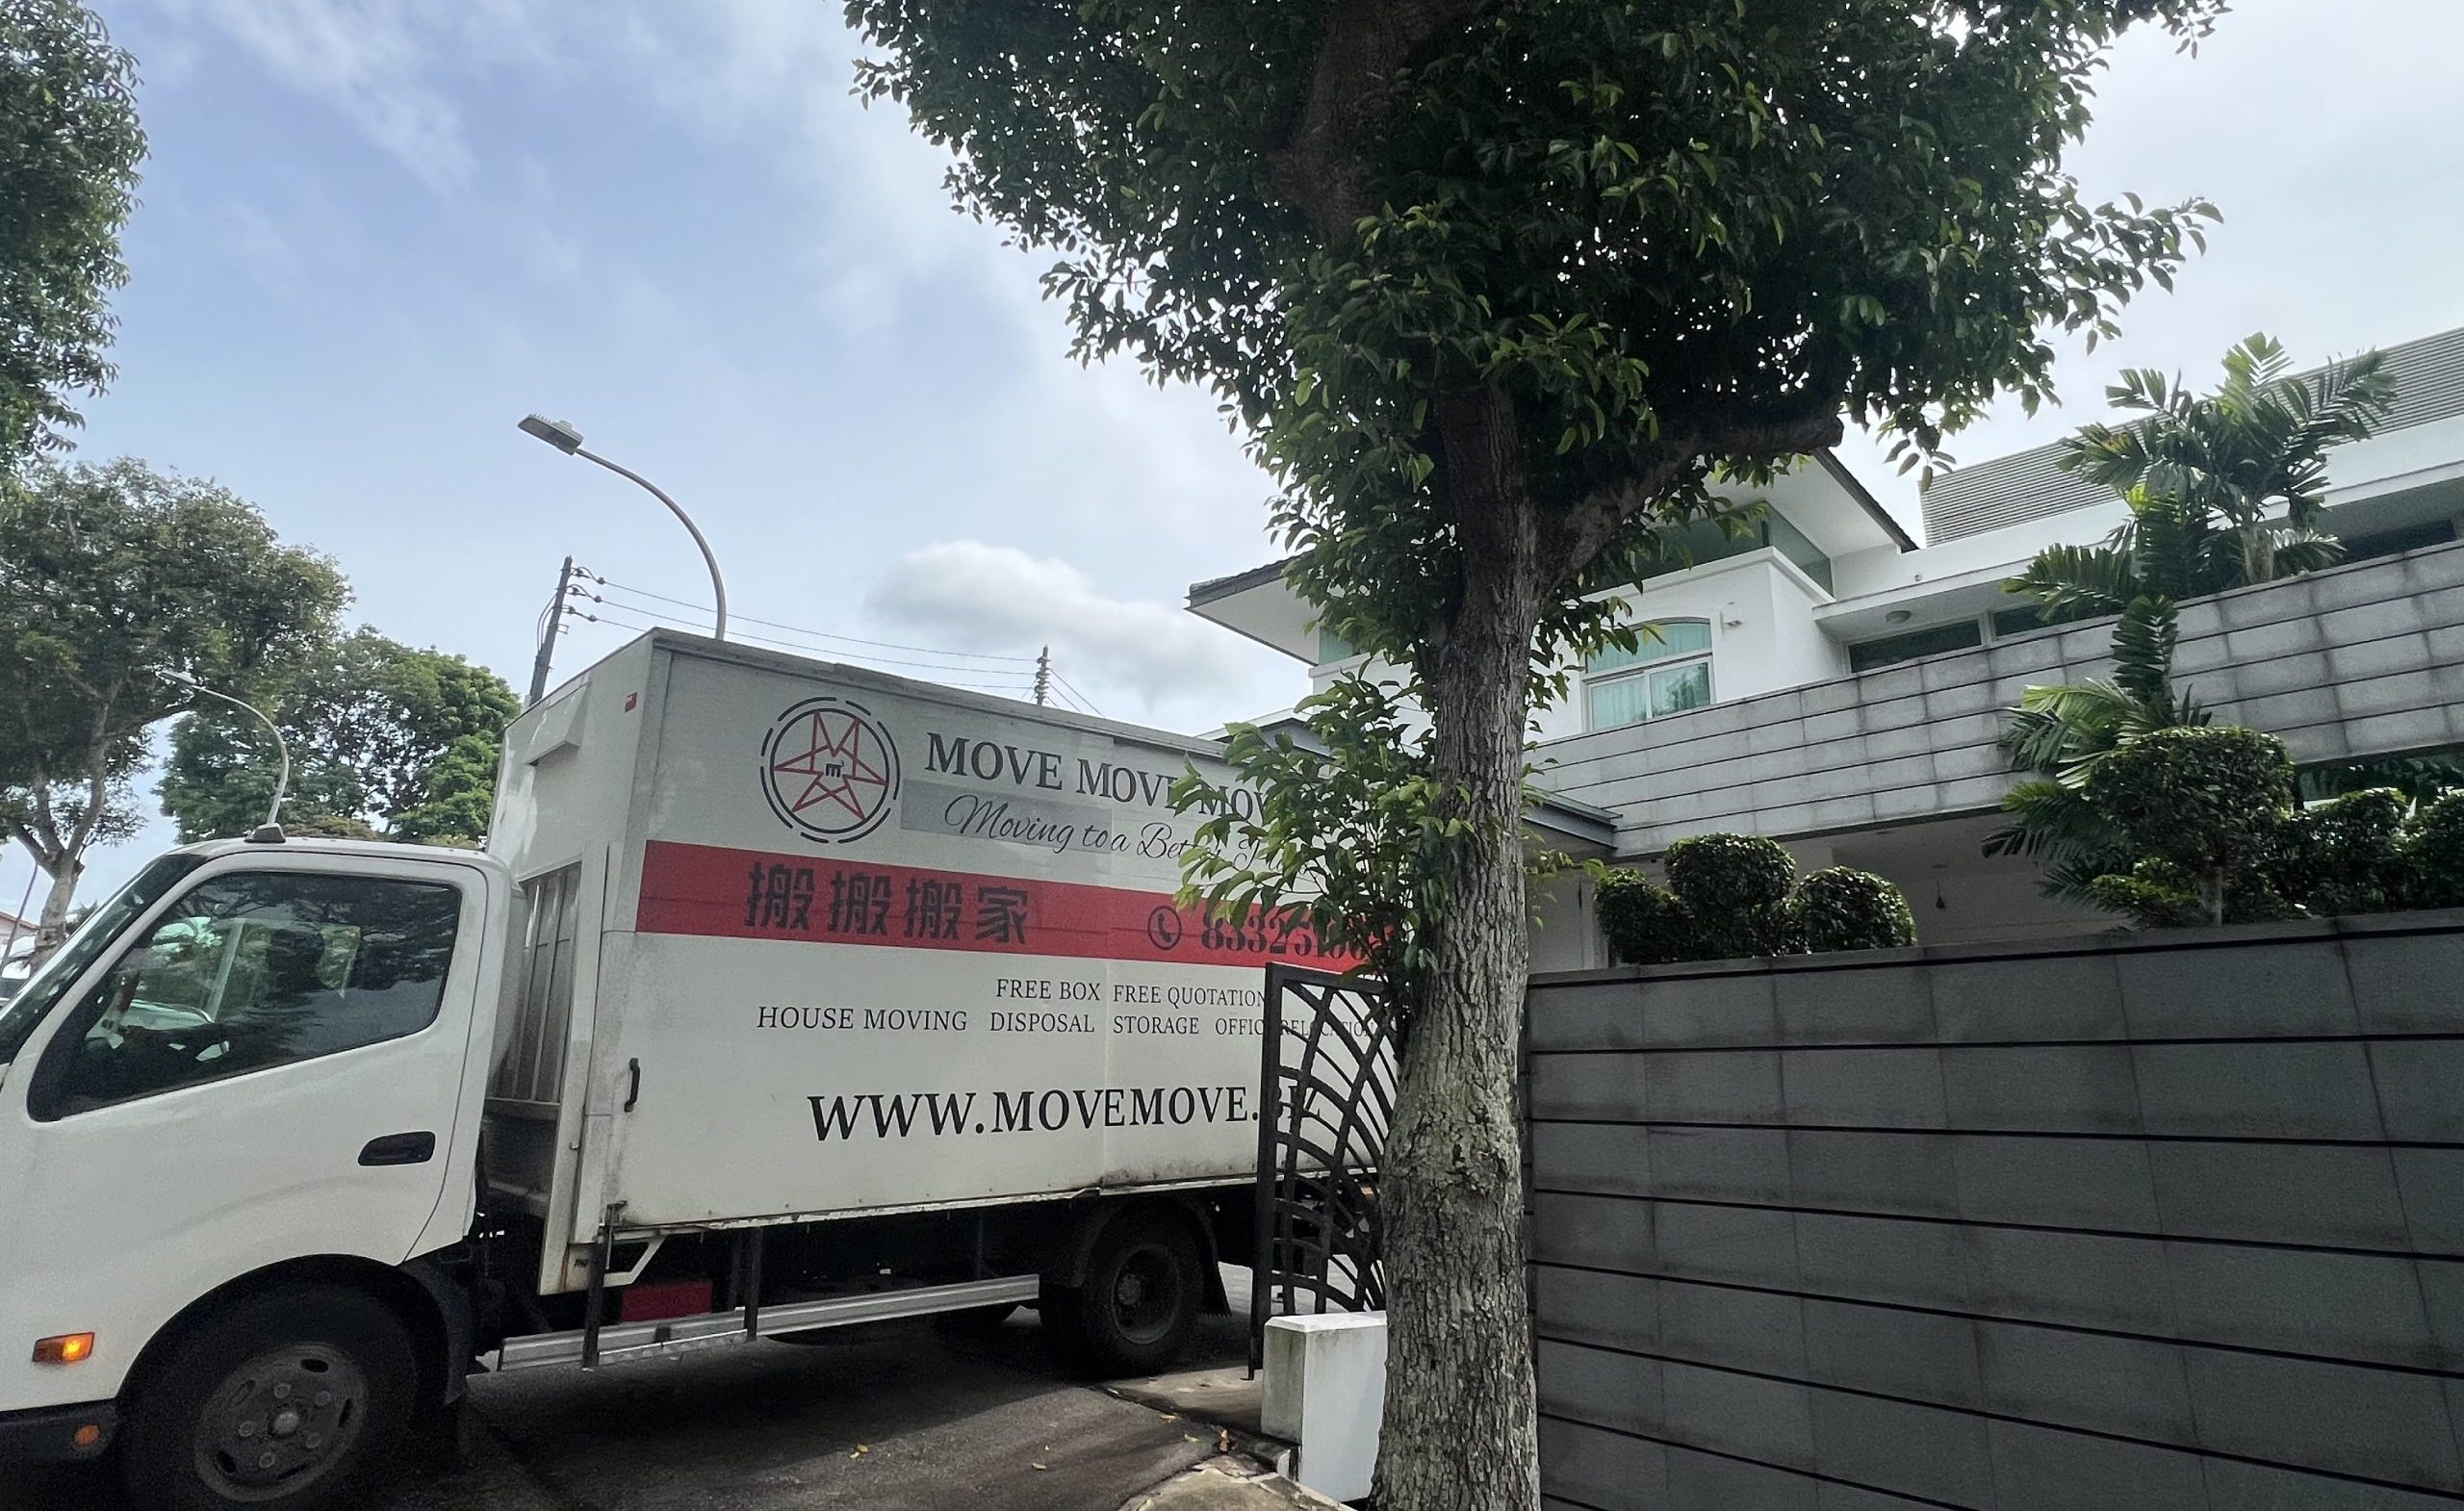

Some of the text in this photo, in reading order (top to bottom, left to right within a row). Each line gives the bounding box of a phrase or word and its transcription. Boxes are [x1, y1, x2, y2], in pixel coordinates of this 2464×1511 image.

[924, 731, 1063, 791] MOVE
[944, 794, 1075, 854] Moving
[1082, 824, 1108, 849] to
[1111, 833, 1131, 852] a
[1137, 822, 1222, 859] Bet
[744, 861, 1029, 944] 搬搬搬家
[757, 1006, 855, 1030] HOUSE
[862, 1009, 968, 1032] MOVING
[989, 1012, 1095, 1034] DISPOSAL
[1113, 1014, 1199, 1035] STORAGE
[1215, 1016, 1265, 1036] OFFIC
[995, 978, 1052, 999] FREE
[1059, 981, 1101, 1002] BOX
[1113, 985, 1162, 1004] FREE
